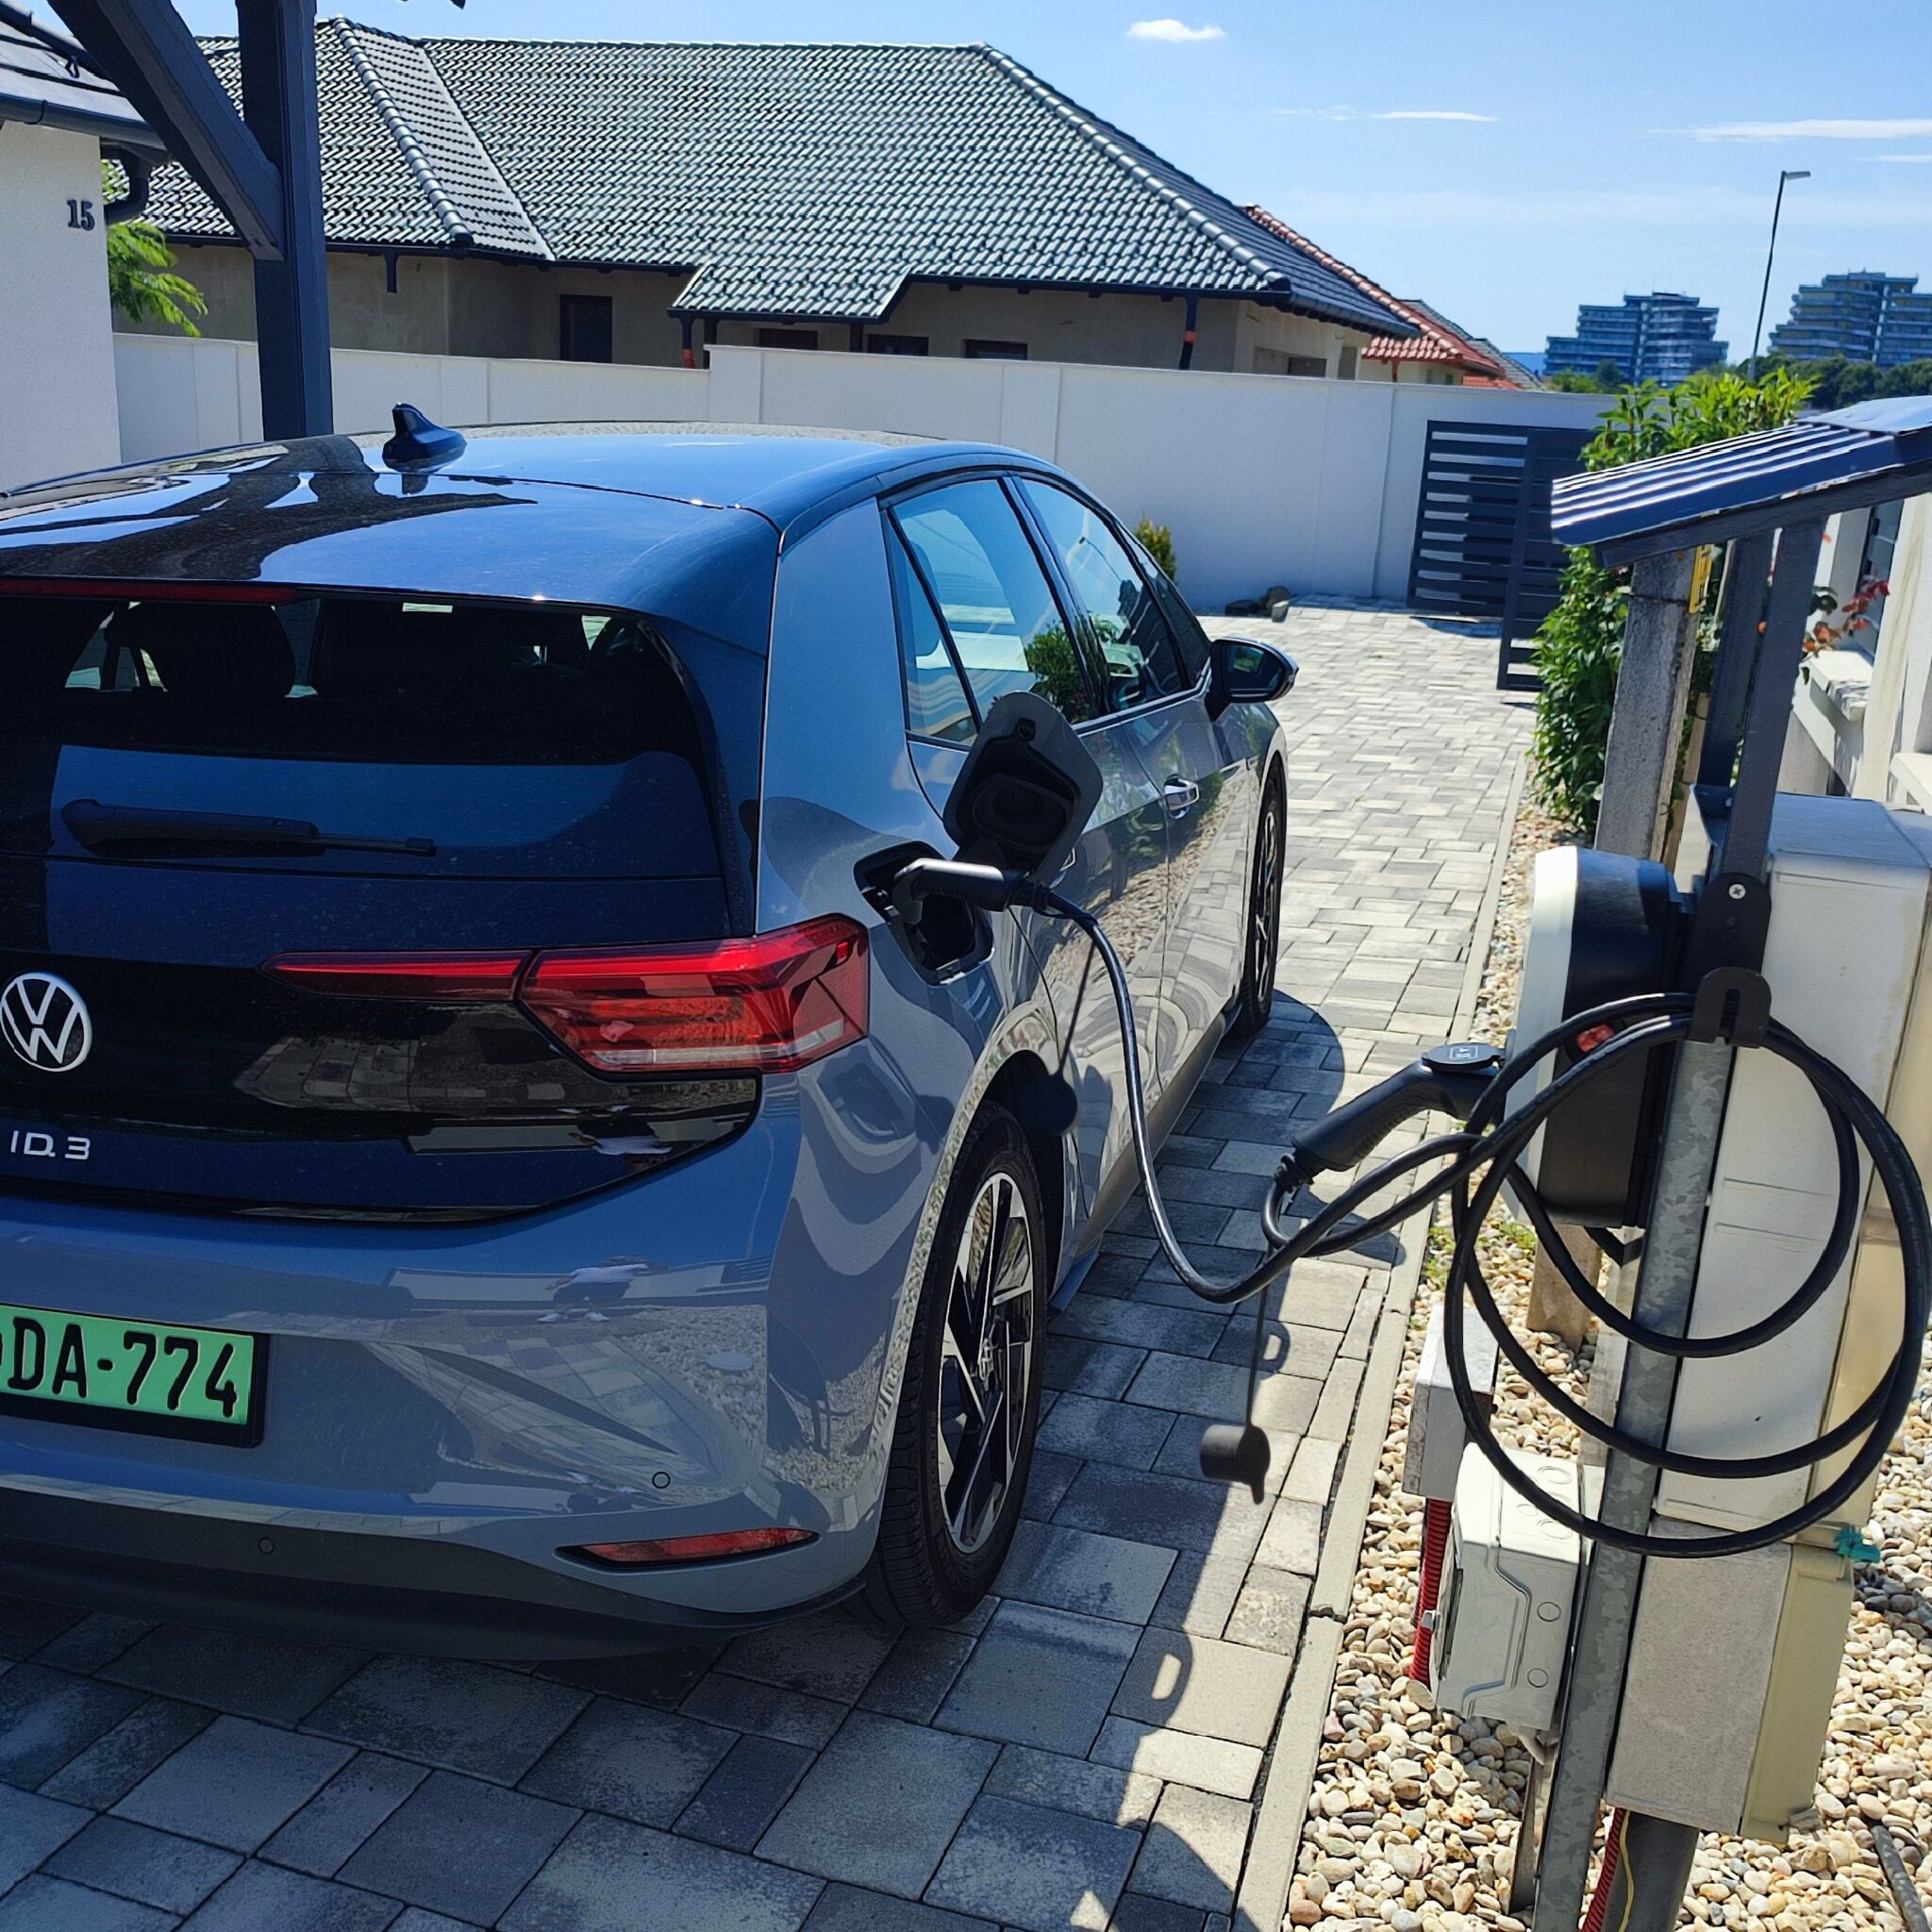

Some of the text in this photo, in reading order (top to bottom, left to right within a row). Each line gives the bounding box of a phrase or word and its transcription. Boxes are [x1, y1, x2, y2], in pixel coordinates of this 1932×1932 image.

[67, 199, 95, 231] 15
[0, 974, 90, 1070] VW
[8, 1316, 238, 1418] DA-774
